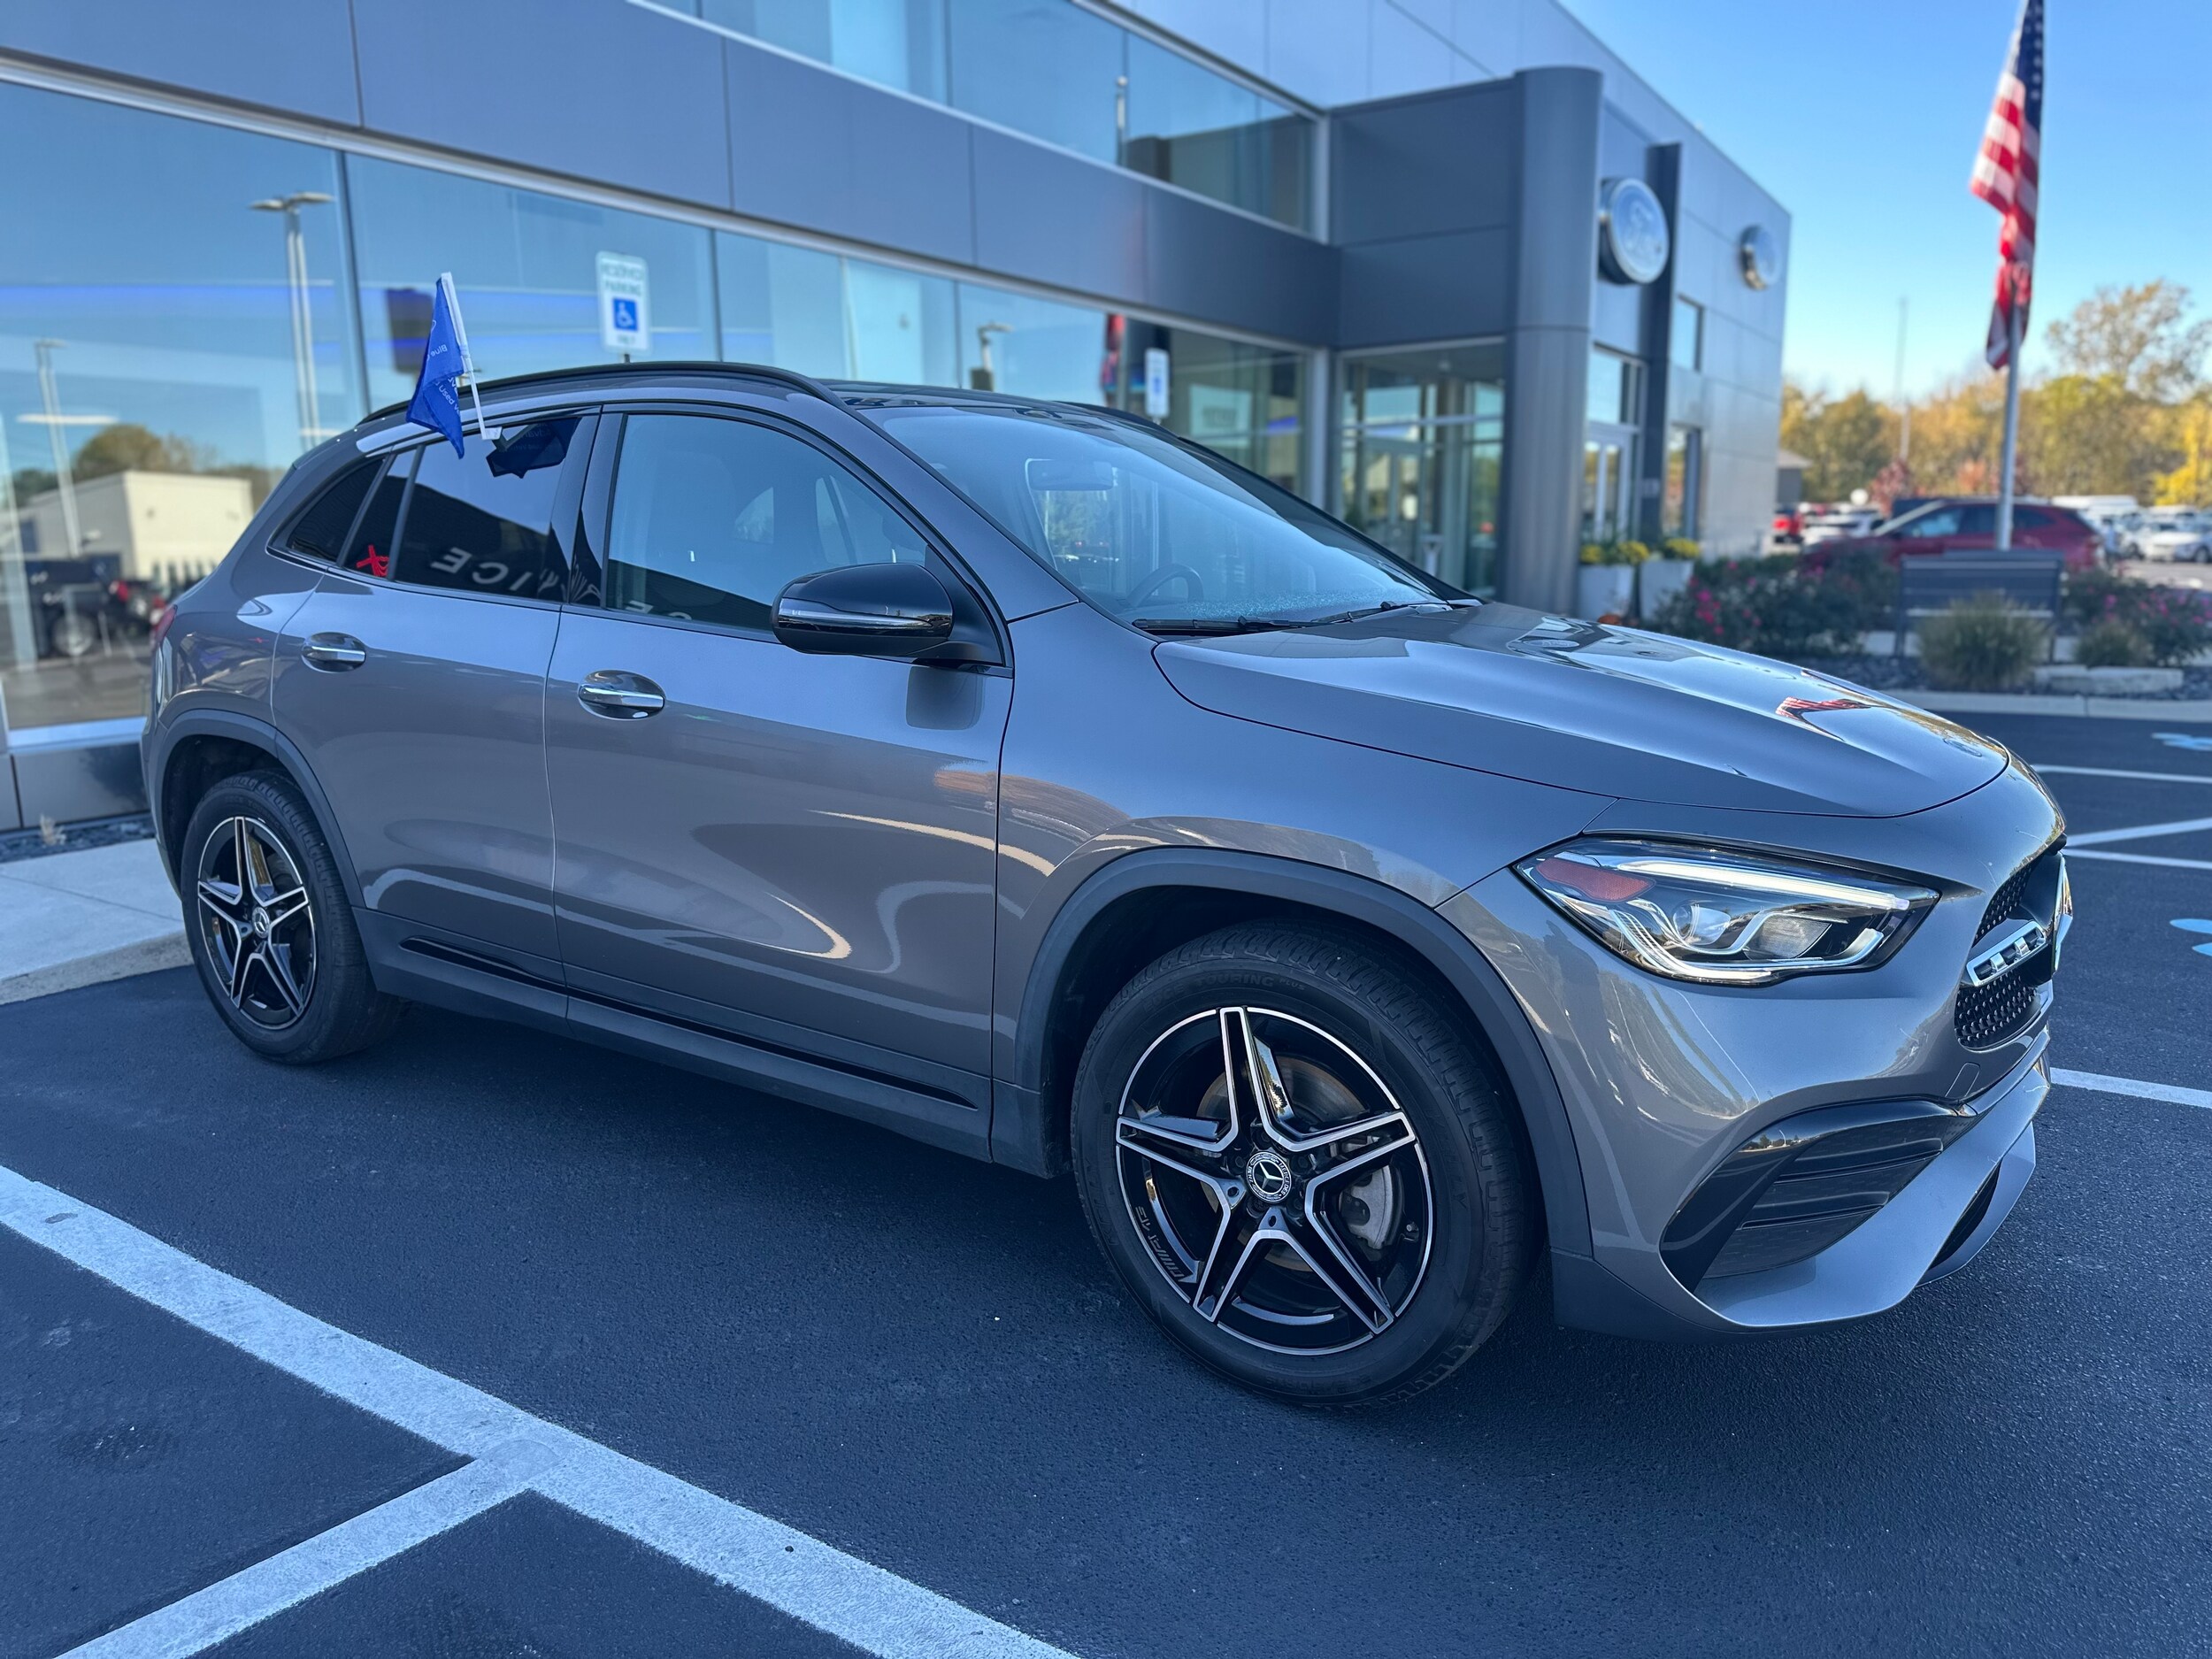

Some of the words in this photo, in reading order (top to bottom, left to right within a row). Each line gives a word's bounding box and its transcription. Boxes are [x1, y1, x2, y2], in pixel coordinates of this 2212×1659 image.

[438, 384, 455, 405] Used
[1194, 973, 1276, 987] TOURING
[1279, 977, 1306, 990] PLUS
